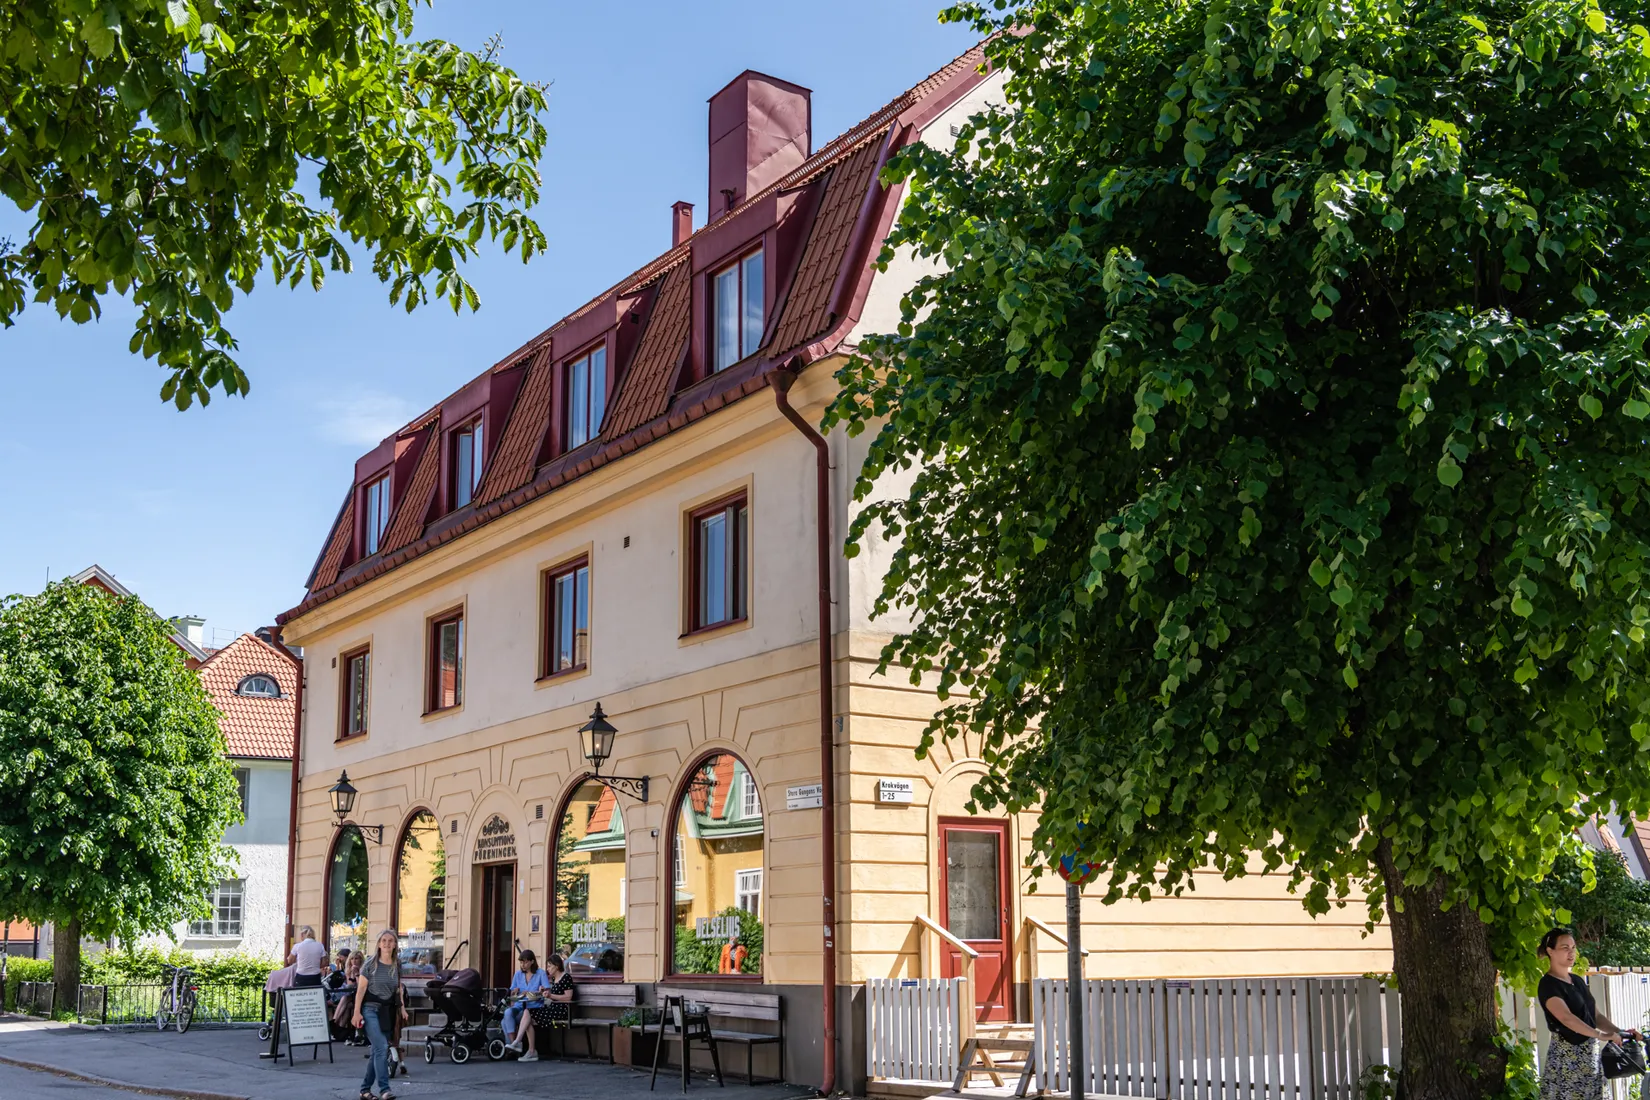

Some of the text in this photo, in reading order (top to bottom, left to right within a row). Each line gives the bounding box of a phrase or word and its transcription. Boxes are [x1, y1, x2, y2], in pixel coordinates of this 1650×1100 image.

[881, 780, 909, 791] Krokvägen
[881, 792, 895, 800] 1-25
[572, 922, 608, 943] DELSELIUS
[695, 916, 740, 939] DELSELIUS
